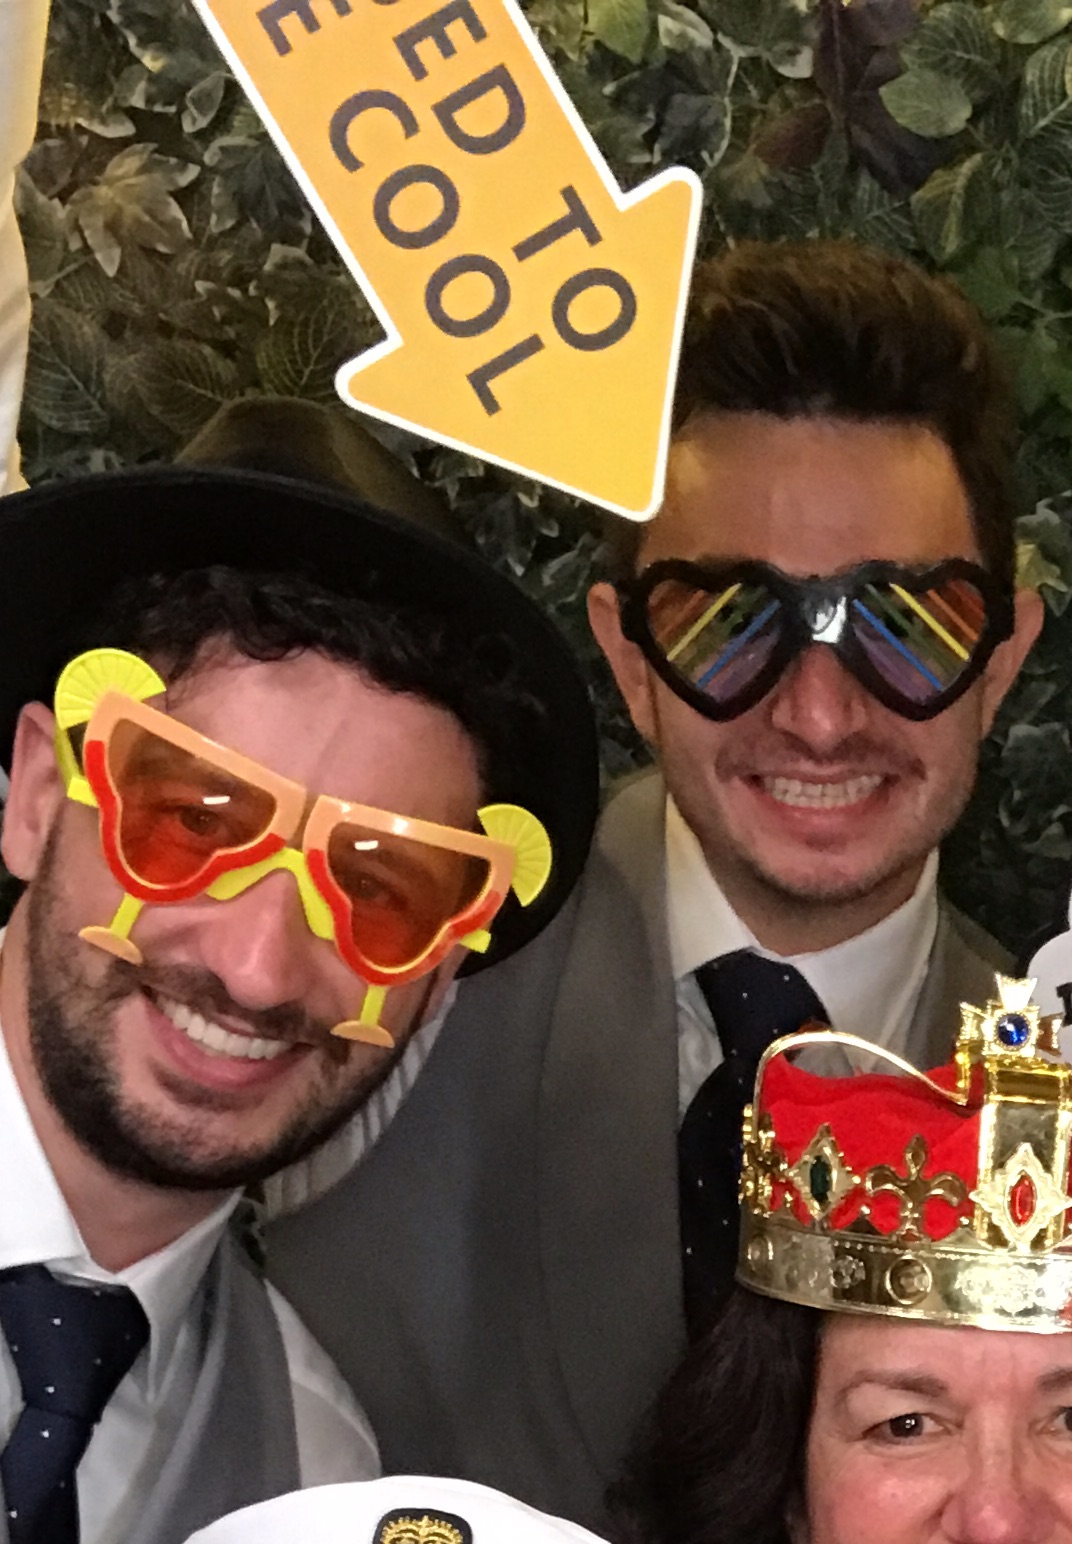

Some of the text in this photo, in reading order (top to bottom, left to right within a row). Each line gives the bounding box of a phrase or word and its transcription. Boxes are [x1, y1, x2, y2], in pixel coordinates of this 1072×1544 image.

[257, 0, 544, 416] E COOL
[372, 0, 637, 352] ED TO
